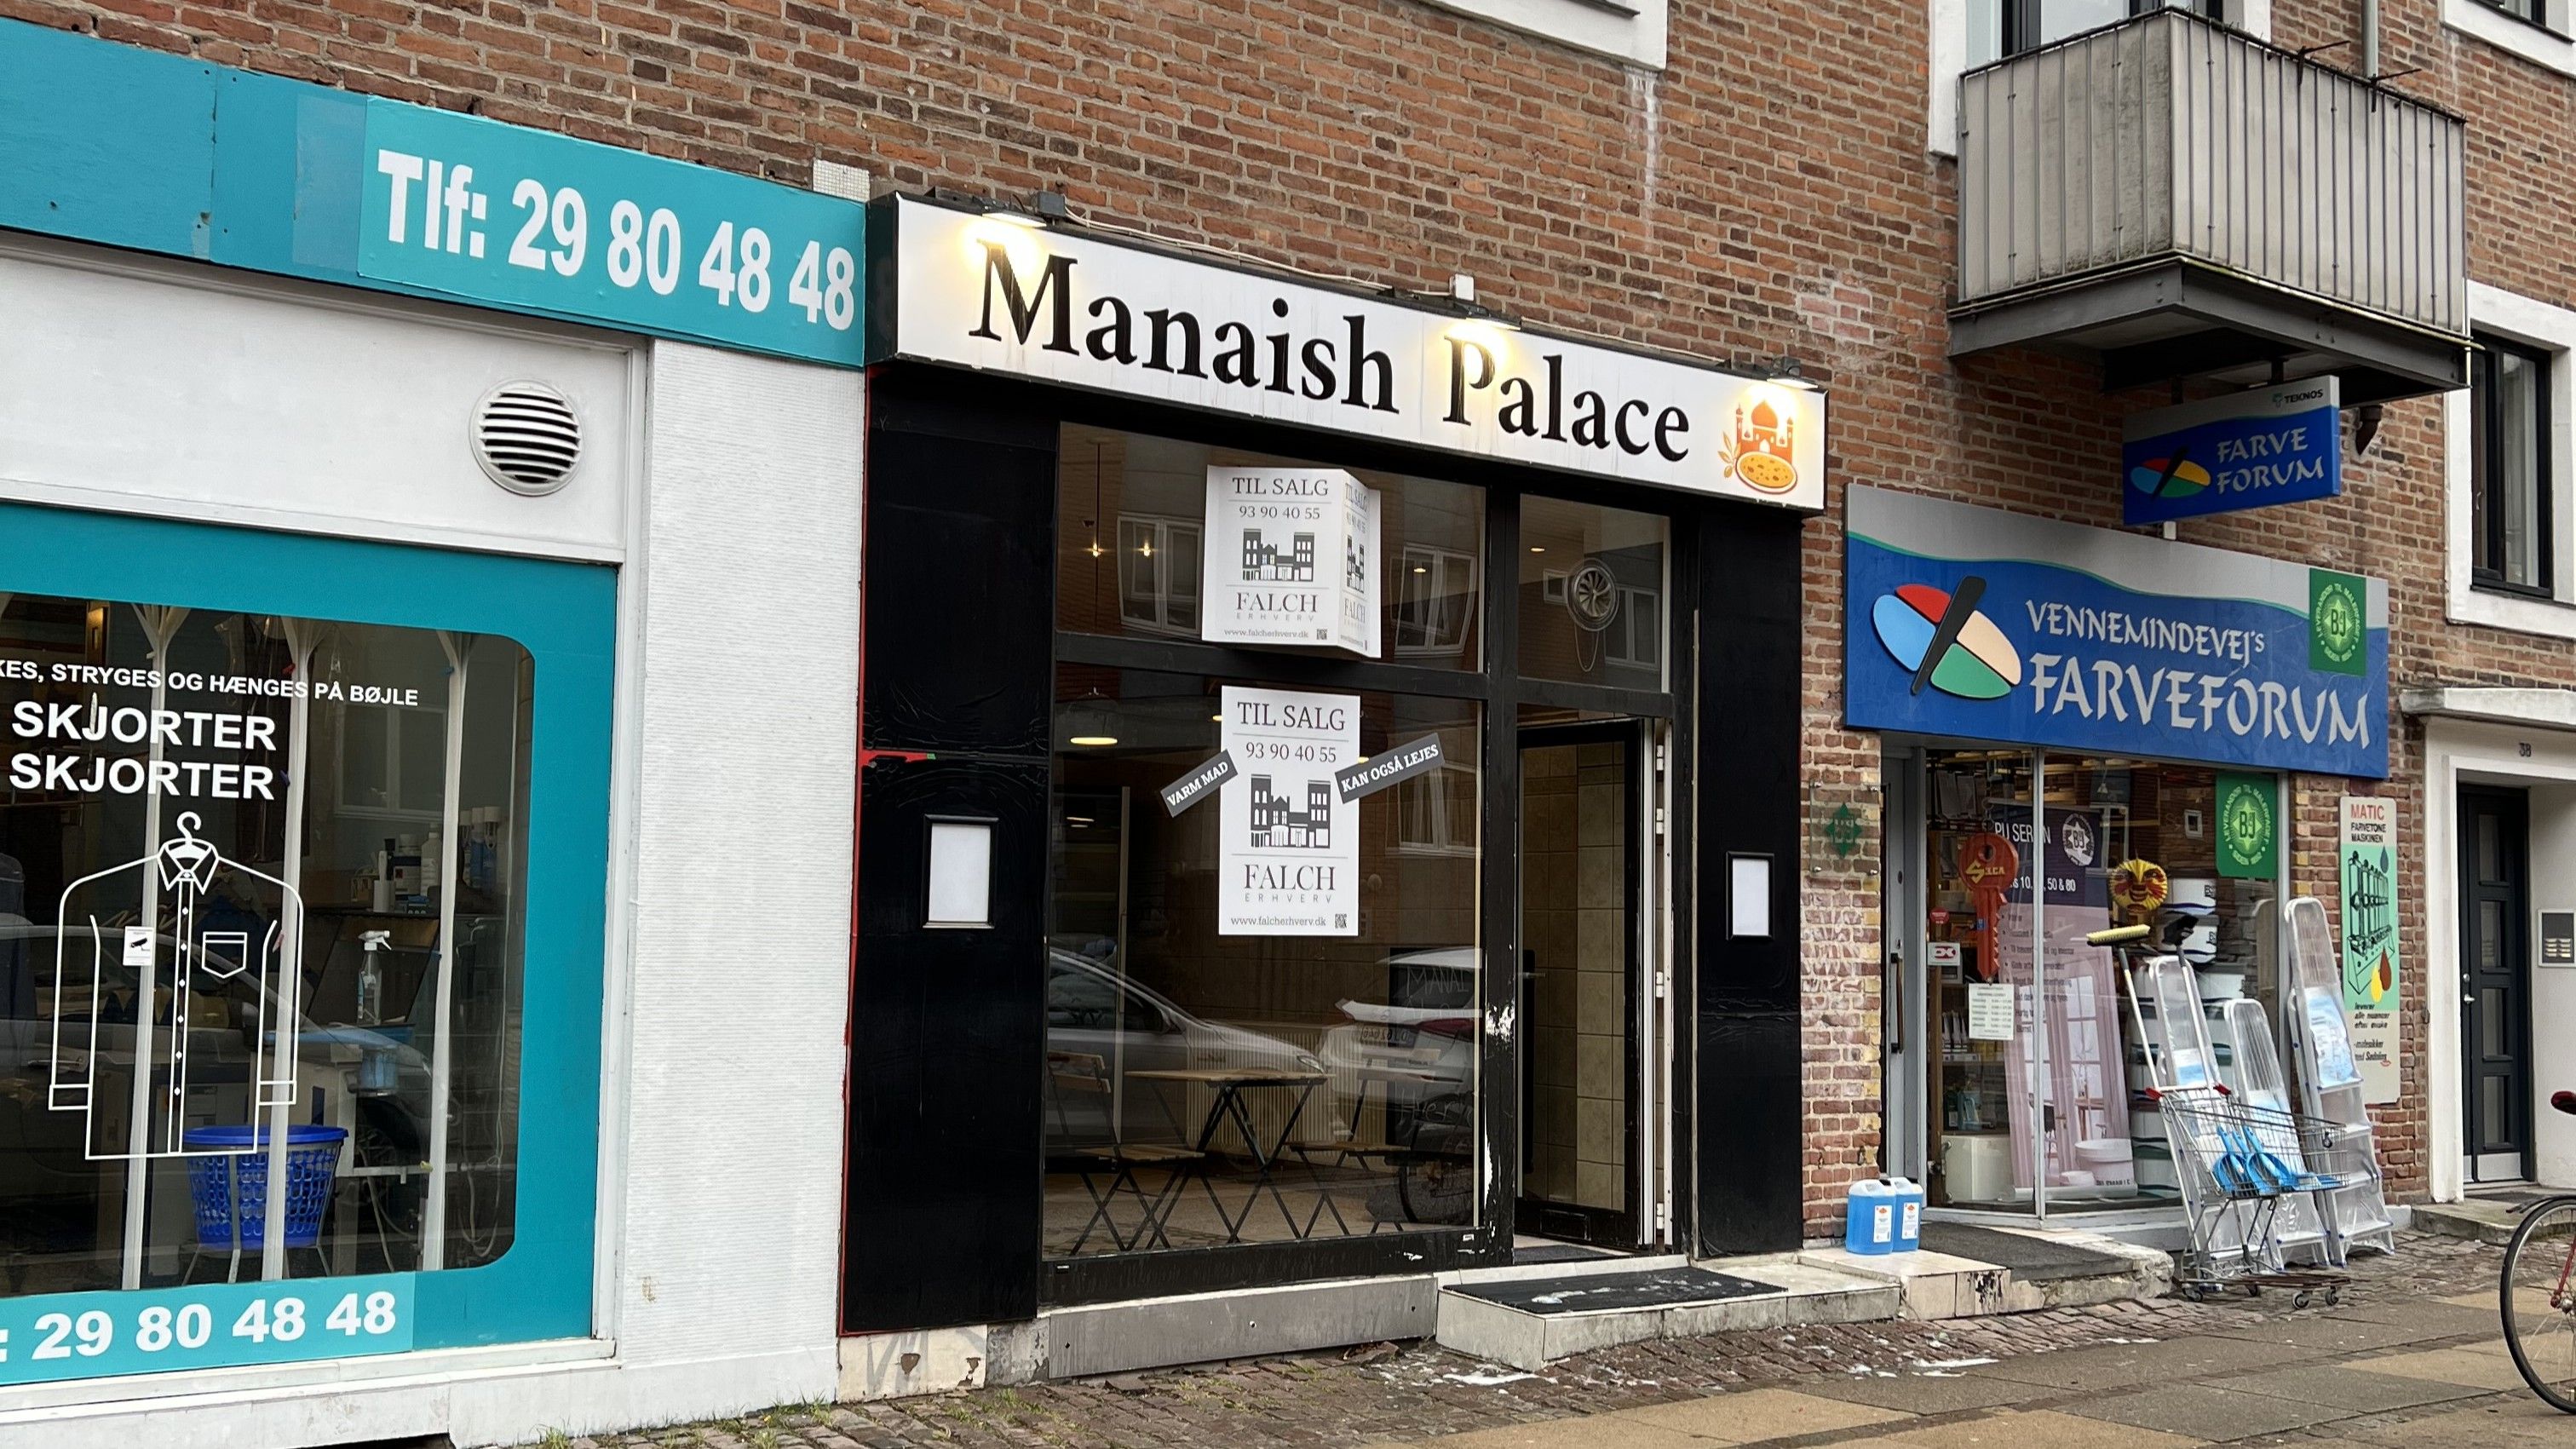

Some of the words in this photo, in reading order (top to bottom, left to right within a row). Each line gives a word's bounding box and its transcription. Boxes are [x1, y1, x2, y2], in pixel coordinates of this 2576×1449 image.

[377, 148, 486, 259] Tlf:
[508, 178, 588, 277] 29
[607, 198, 681, 296] 80
[699, 221, 771, 313] 48
[788, 240, 854, 331] 48
[969, 238, 1400, 417] Manaish
[1441, 332, 1691, 463] Palace
[2284, 388, 2323, 404] TEKNOS
[2217, 426, 2309, 464] FARVE
[1232, 476, 1267, 496] TIL
[1272, 477, 1329, 497] SALG
[2217, 455, 2325, 495] FORUM
[1239, 505, 1256, 518] 93
[1260, 506, 1278, 519] 90
[1282, 506, 1300, 520] 40
[1304, 507, 1320, 520] 55
[1236, 592, 1318, 613] FALCH
[1237, 612, 1314, 622] ERHVERV
[51, 664, 162, 688] STRYGES
[168, 671, 204, 692] OG
[210, 674, 308, 699] HÆNGES
[314, 681, 344, 701] PÅ
[349, 685, 418, 706] BØJLE
[1237, 701, 1276, 727] TIL
[1282, 704, 1345, 731] SALG
[2028, 652, 2370, 750] FARVEFORUM
[12, 700, 277, 751] SKJORTER
[1245, 741, 1265, 760] 93
[1269, 743, 1290, 760] 90
[1294, 745, 1314, 762] 40
[1319, 746, 1337, 763] 55
[9, 752, 274, 801] SKJORTER
[1340, 772, 1370, 793] KAN
[1369, 755, 1405, 781] OGSÅ
[1402, 744, 1440, 768] LEJES
[1166, 777, 1202, 808] VARM
[1200, 761, 1229, 787] MAD
[2351, 804, 2384, 821] MATIC
[1243, 863, 1336, 892] FALCH
[2047, 879, 2058, 891] 50
[1244, 894, 1332, 904] ERHVERV
[1230, 915, 1326, 928] www.falcherhverv.dk
[31, 1310, 114, 1360] 29
[135, 1302, 212, 1352] 80
[232, 1297, 307, 1343] 48
[325, 1291, 396, 1336] 48
